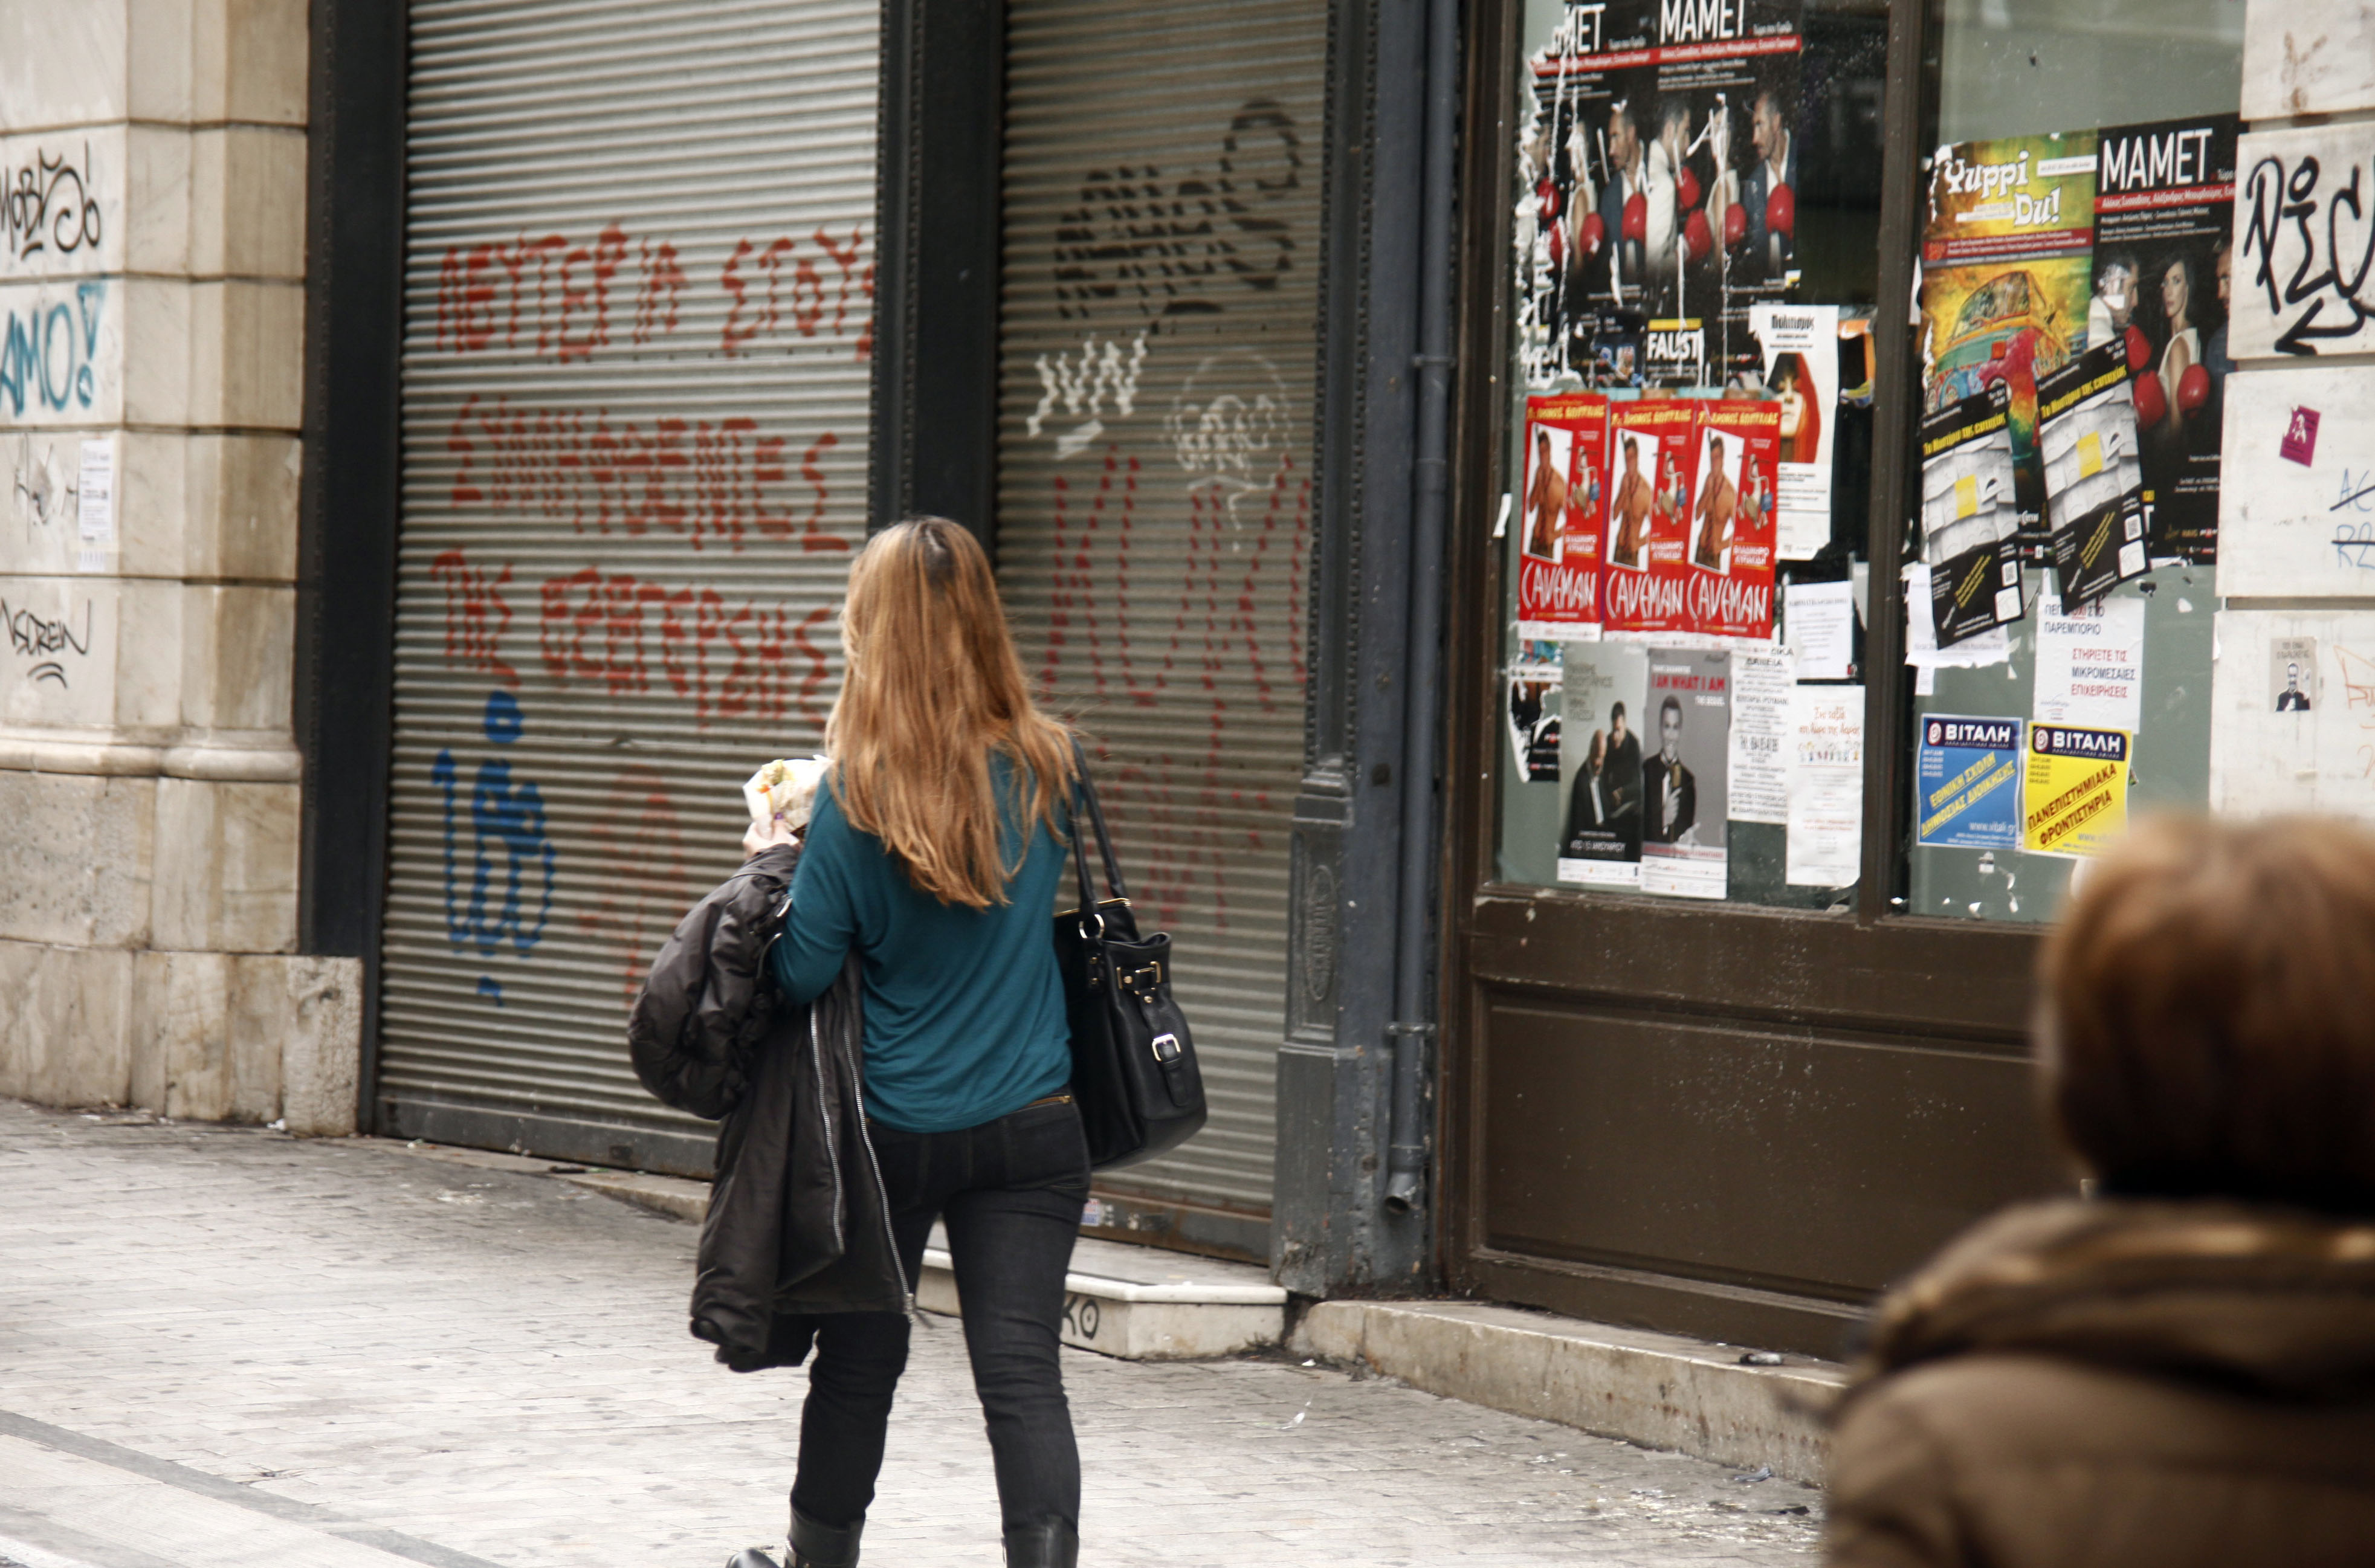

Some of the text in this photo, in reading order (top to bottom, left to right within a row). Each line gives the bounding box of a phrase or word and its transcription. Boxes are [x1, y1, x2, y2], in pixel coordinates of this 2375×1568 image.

[1944, 150, 2029, 199] Yuppi
[2102, 128, 2213, 192] MAMET
[2014, 184, 2062, 226] Du!
[1647, 331, 1699, 361] FAUST
[1522, 562, 1597, 610] CAVEMAN
[1606, 570, 1684, 620] CAVEMAN
[1687, 571, 1768, 624] CAVEMAN
[2044, 622, 2101, 635] ΠΑΡΕΜΠΟΡΙΟ
[2072, 666, 2136, 680] ΜΙΚΡΟΜΕΣΑΙΕΣ
[2115, 650, 2127, 662] ΤΙΣ
[1651, 673, 1725, 691] I AM WHAT I AM
[2071, 684, 2128, 698] ΕΠΙΧΕΙΡΗΣΕΙΣ
[1945, 724, 2011, 742] ΒΙΤΑΛΗ
[2053, 731, 2121, 753] ΒΙΤΑΛΗ
[1930, 773, 1965, 808] ΕΘΝΙΚΗ
[1964, 751, 1996, 783] ΣΧΟΛΗ
[2028, 763, 2117, 830] ΠΑΝΕΠΙΣΤΗΜΙΑΚΑ
[1921, 794, 1966, 836] ΔΗΜΟΣΙΑΣ
[2040, 790, 2113, 845] ΦΡΟΝΤΙΣΤΗΡΙΑ
